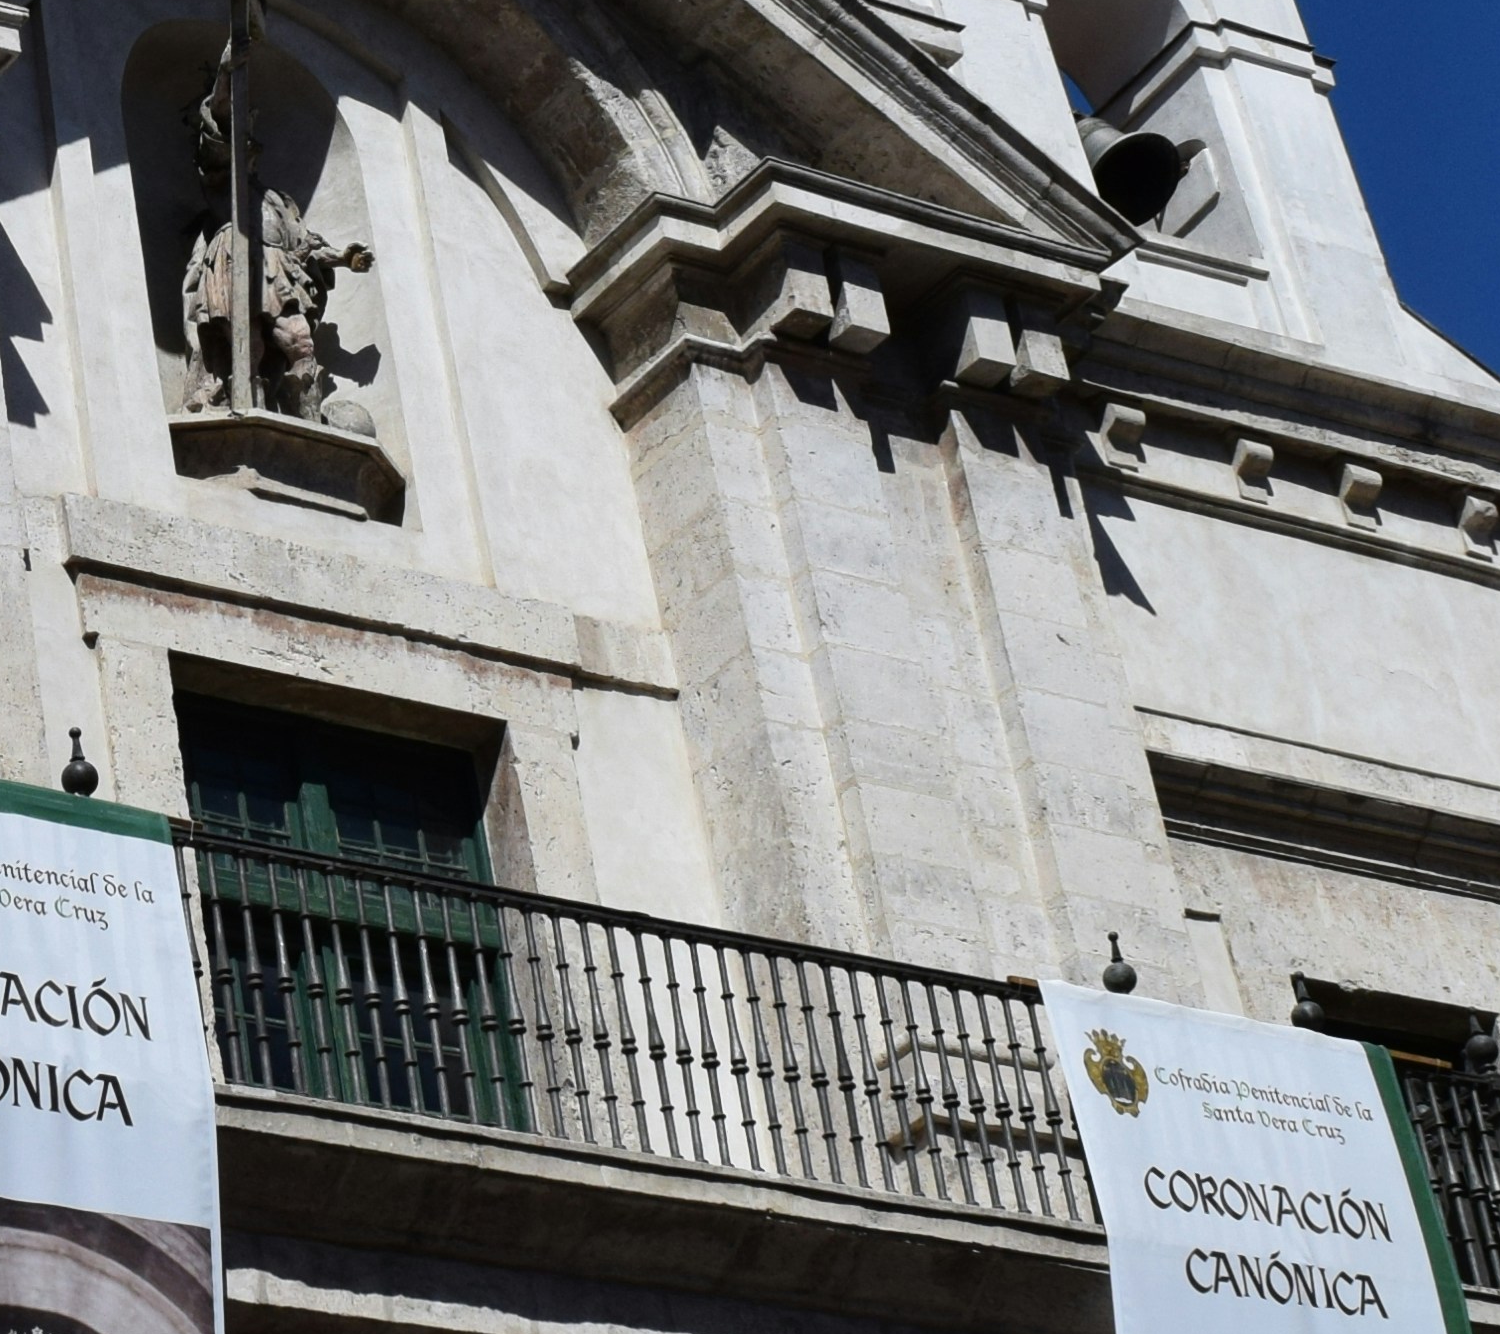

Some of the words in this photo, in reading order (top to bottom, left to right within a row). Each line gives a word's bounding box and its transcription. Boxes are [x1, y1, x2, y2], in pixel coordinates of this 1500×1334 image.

[103, 874, 129, 899] de
[134, 880, 155, 904] la
[55, 895, 109, 931] Cruz
[1231, 1079, 1331, 1114] Penitencial
[1332, 1096, 1352, 1118] de
[1354, 1101, 1374, 1122] la
[1202, 1101, 1255, 1126] Santa
[1258, 1110, 1299, 1134] Vera
[1302, 1118, 1347, 1145] Cruz
[1143, 1166, 1393, 1243] CORONACIÓN
[1185, 1247, 1389, 1319] CANÓNICA
